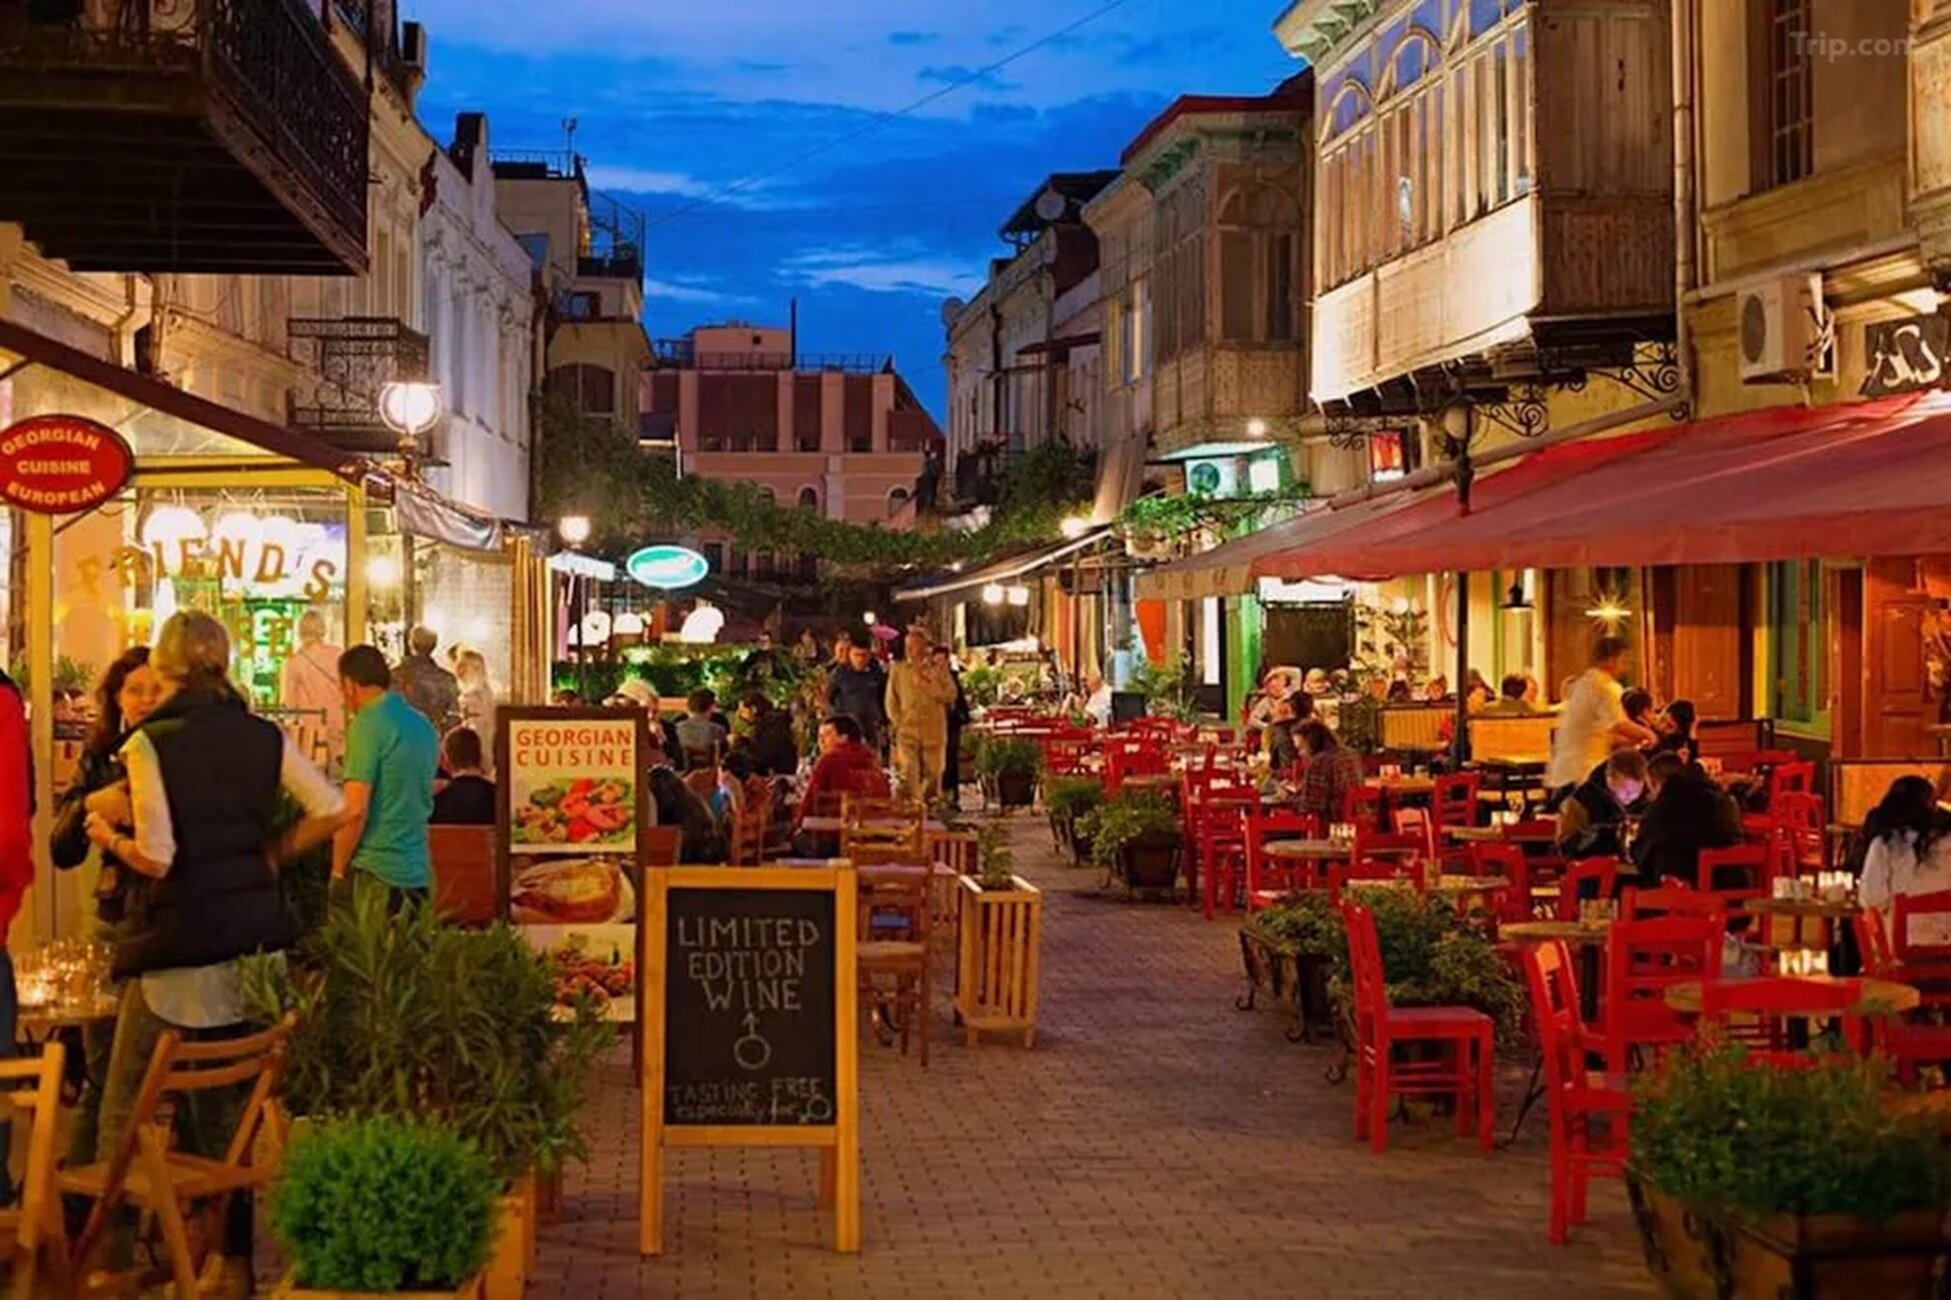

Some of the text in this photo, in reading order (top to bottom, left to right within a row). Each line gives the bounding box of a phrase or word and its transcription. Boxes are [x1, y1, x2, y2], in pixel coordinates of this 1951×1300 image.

[1, 427, 101, 454] GEORGIAN
[16, 461, 92, 476] CUISINE
[6, 480, 106, 506] EUROPEAN
[515, 728, 632, 748] GEORGIAN
[515, 749, 632, 767] CUISINE
[677, 917, 821, 948] LIMITED
[688, 951, 805, 981] EDITION
[702, 978, 802, 1011] WINE
[667, 1077, 825, 1104] TASTING FREE
